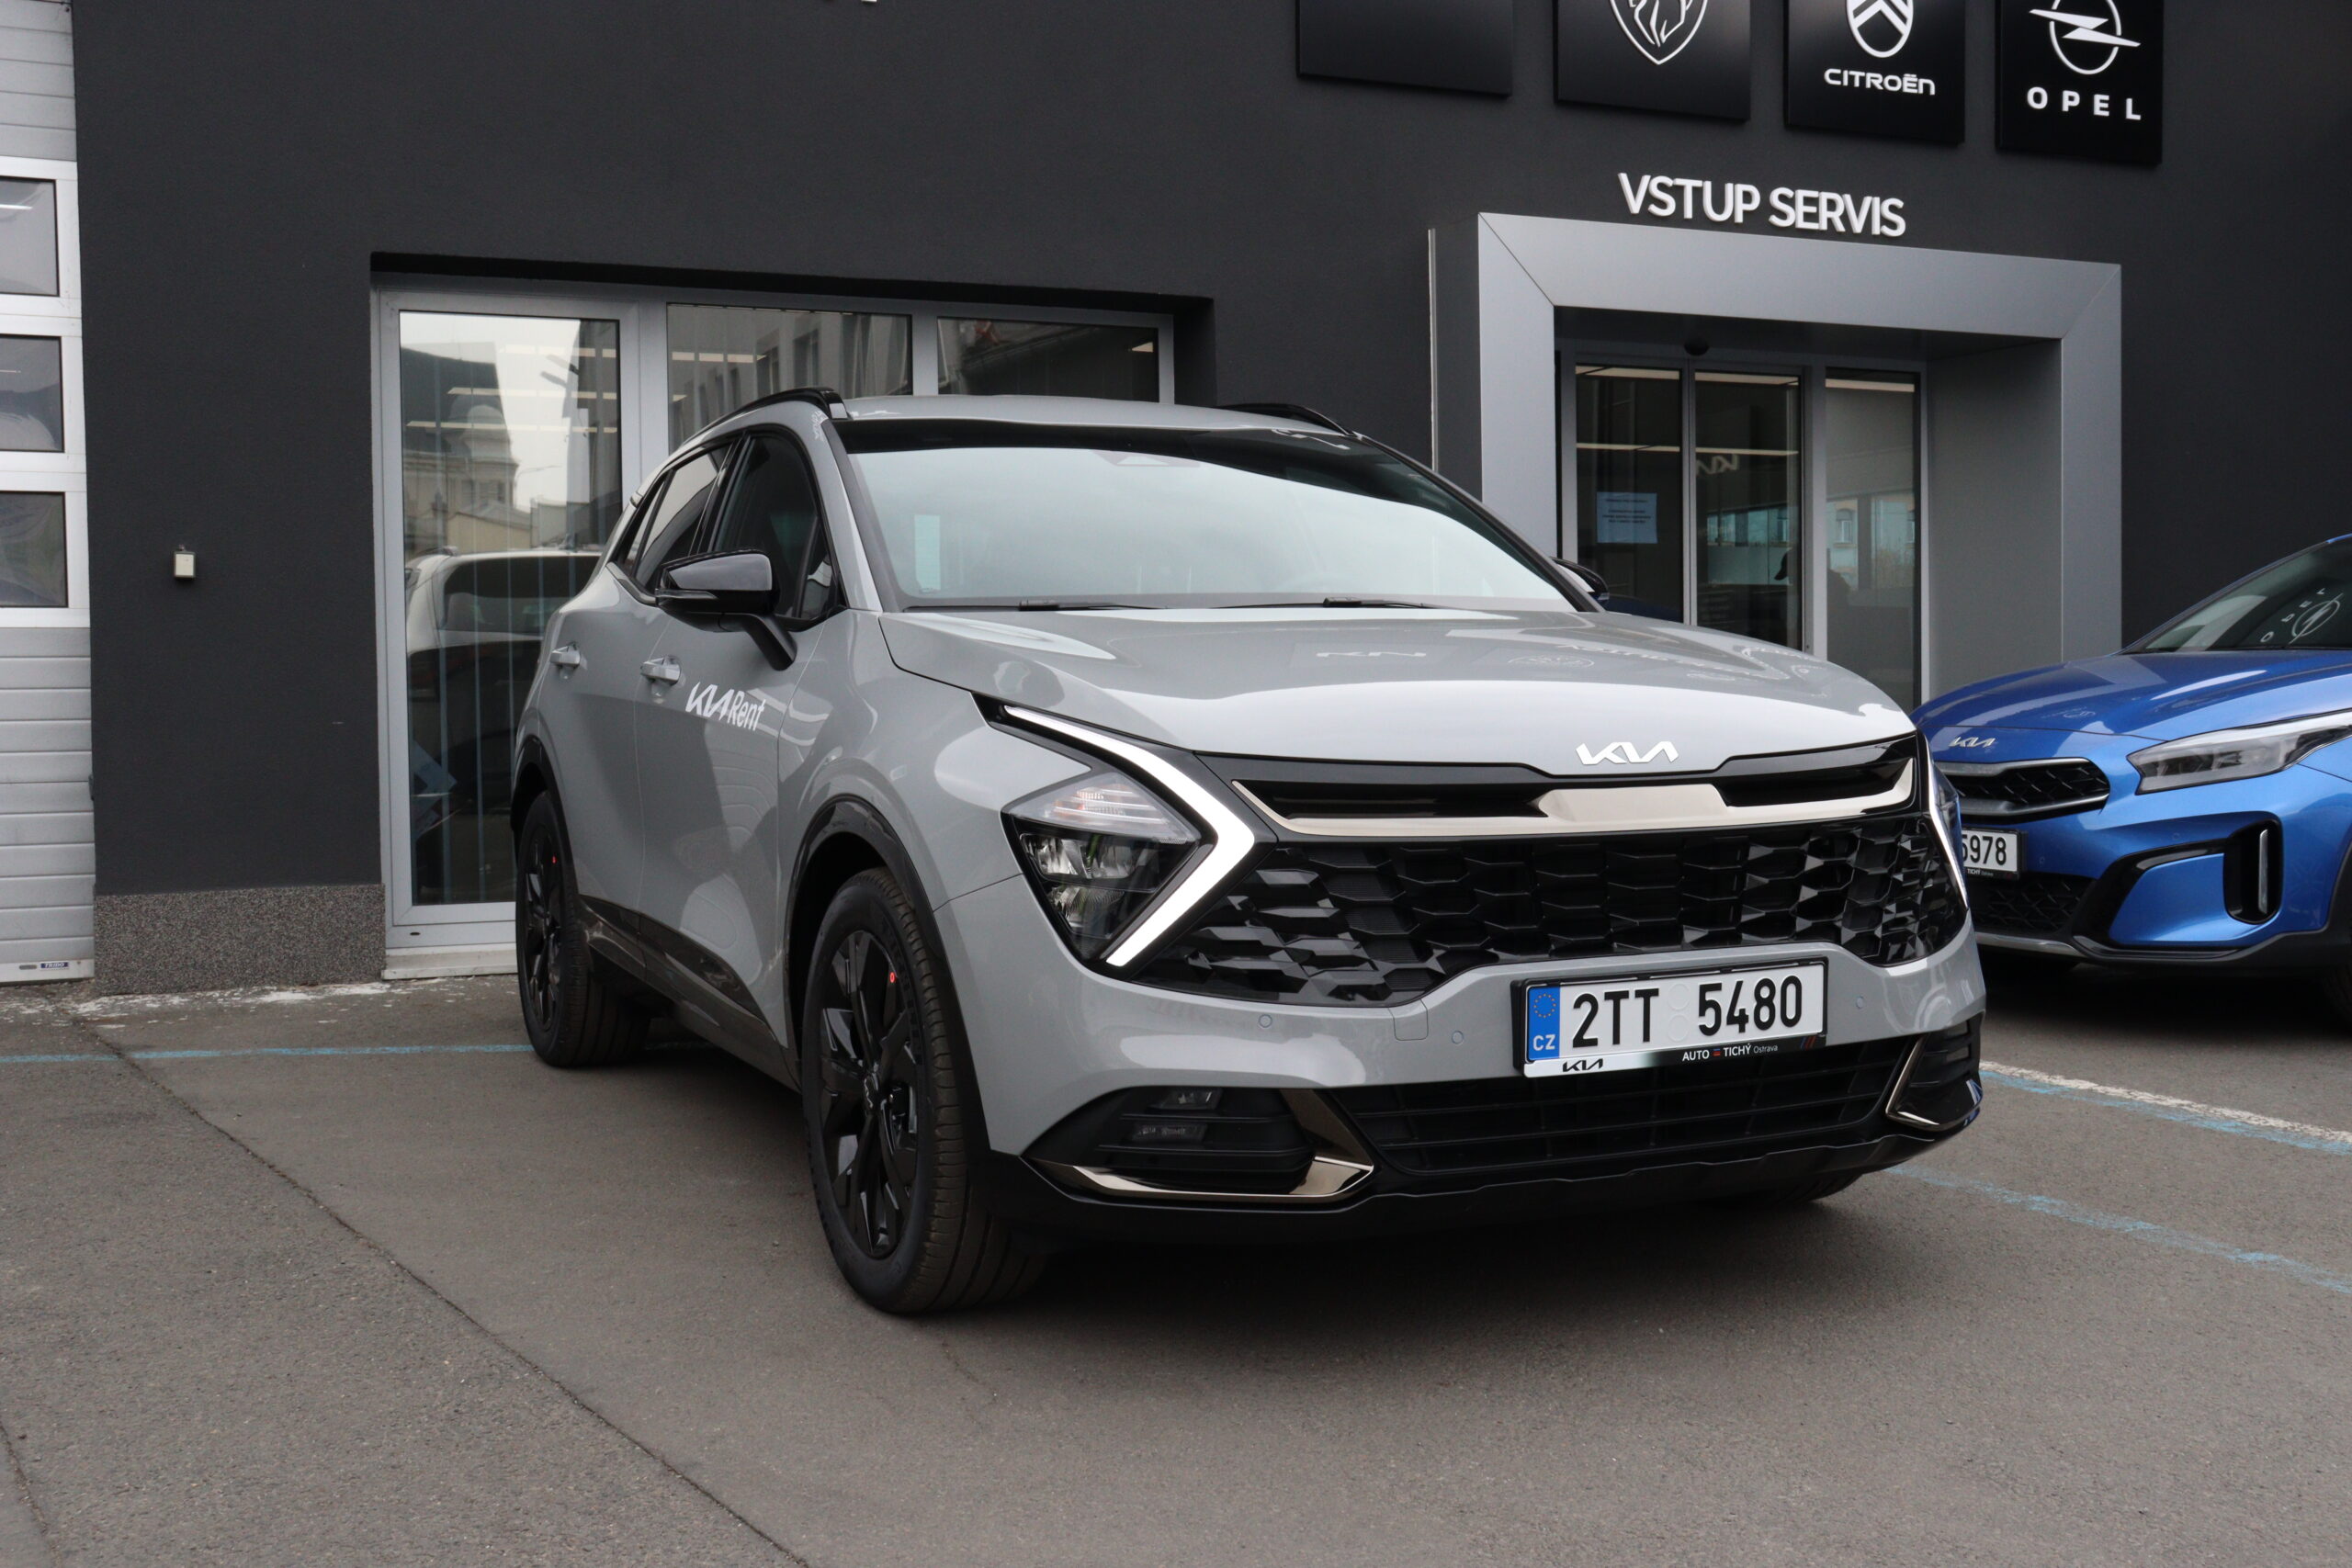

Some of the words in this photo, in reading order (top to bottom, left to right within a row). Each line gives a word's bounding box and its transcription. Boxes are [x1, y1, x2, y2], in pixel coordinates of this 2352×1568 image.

[2027, 86, 2142, 120] OPEL
[1618, 173, 1760, 223] VSTUP
[1769, 186, 1906, 237] SERVIS
[1575, 740, 1679, 765] KIA
[1949, 737, 1996, 748] KIA
[1572, 987, 1659, 1049] 2TT
[1698, 975, 1803, 1037] 5480
[1532, 1033, 1555, 1052] CZ
[1682, 1050, 1710, 1062] AUTO
[1723, 1043, 1752, 1057] TICHÝ
[1753, 1044, 1778, 1055] Ostrava
[1562, 1058, 1604, 1073] KIA
